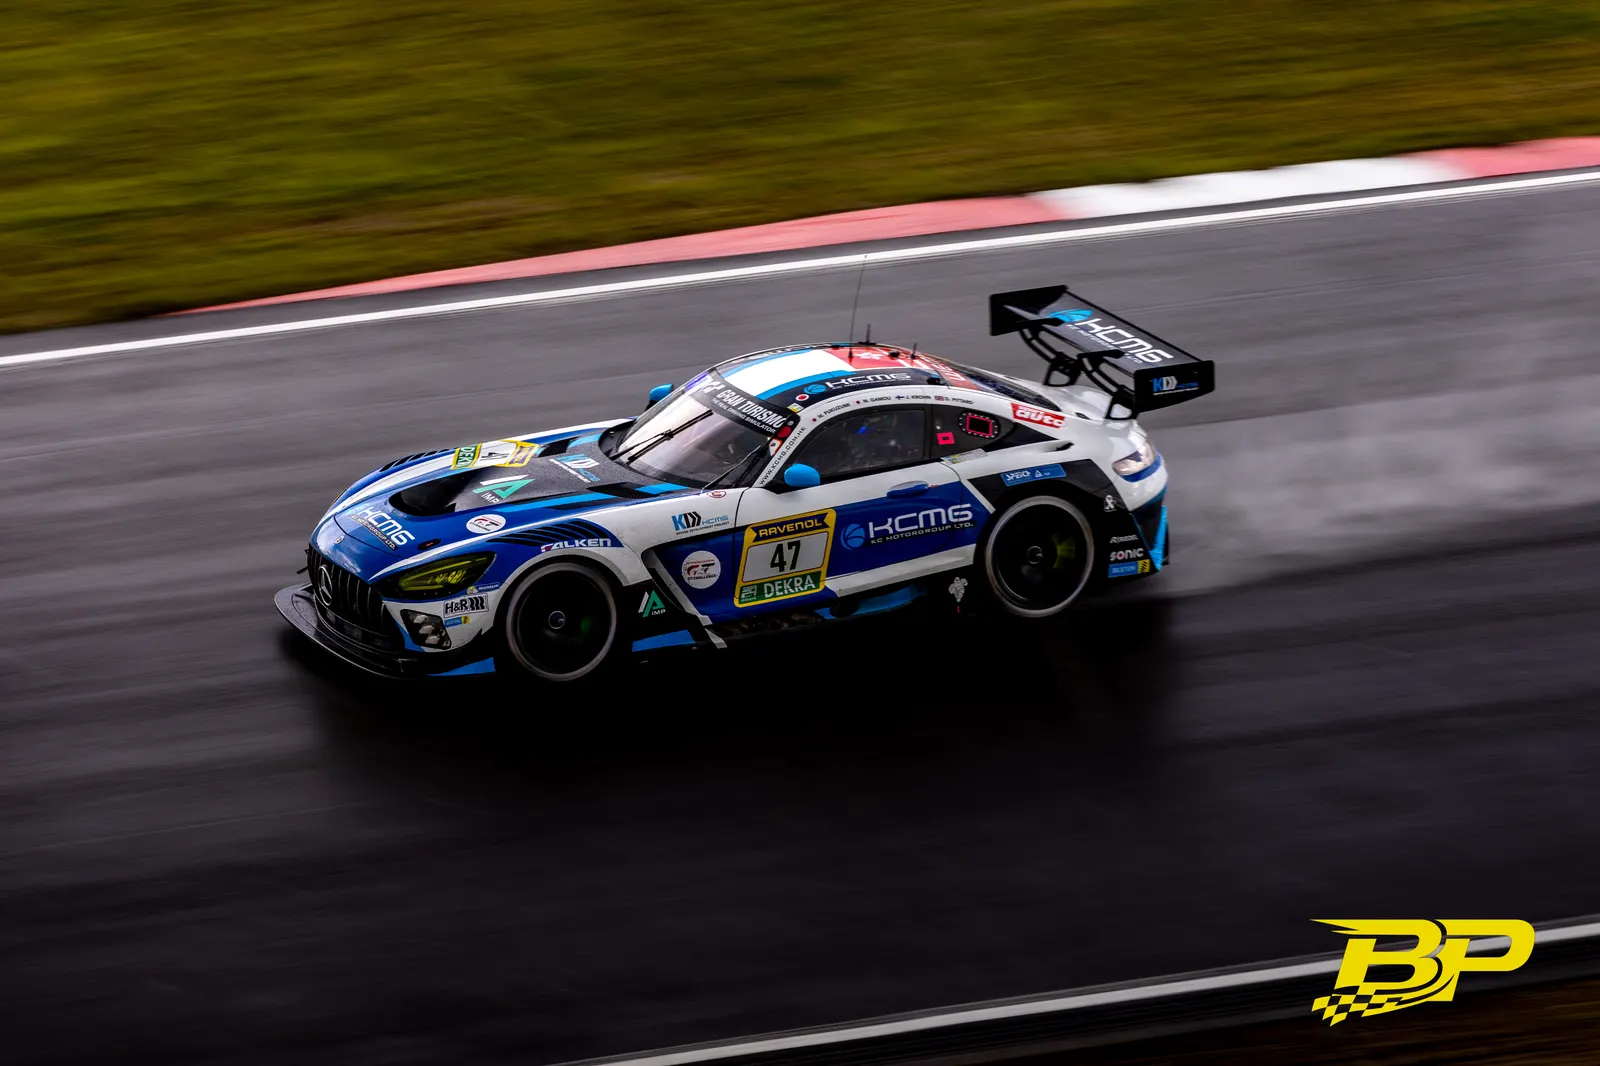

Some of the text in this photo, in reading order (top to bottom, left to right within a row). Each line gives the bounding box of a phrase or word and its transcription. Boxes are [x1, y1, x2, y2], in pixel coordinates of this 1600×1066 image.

[1074, 318, 1174, 363] KCMG
[825, 373, 912, 388] KCMG
[716, 389, 787, 428] GRAN TURISMO
[744, 415, 777, 434] SIMULATOR
[481, 492, 500, 503] IMP
[357, 507, 416, 546] KCMG
[758, 518, 822, 538] RAVENOL
[868, 503, 973, 539] KCMG
[886, 525, 952, 542] MOTORGROUP
[540, 538, 612, 553] FALKEN
[770, 540, 801, 573] 47
[763, 575, 816, 599] DEKRA
[445, 598, 468, 615] H&R
